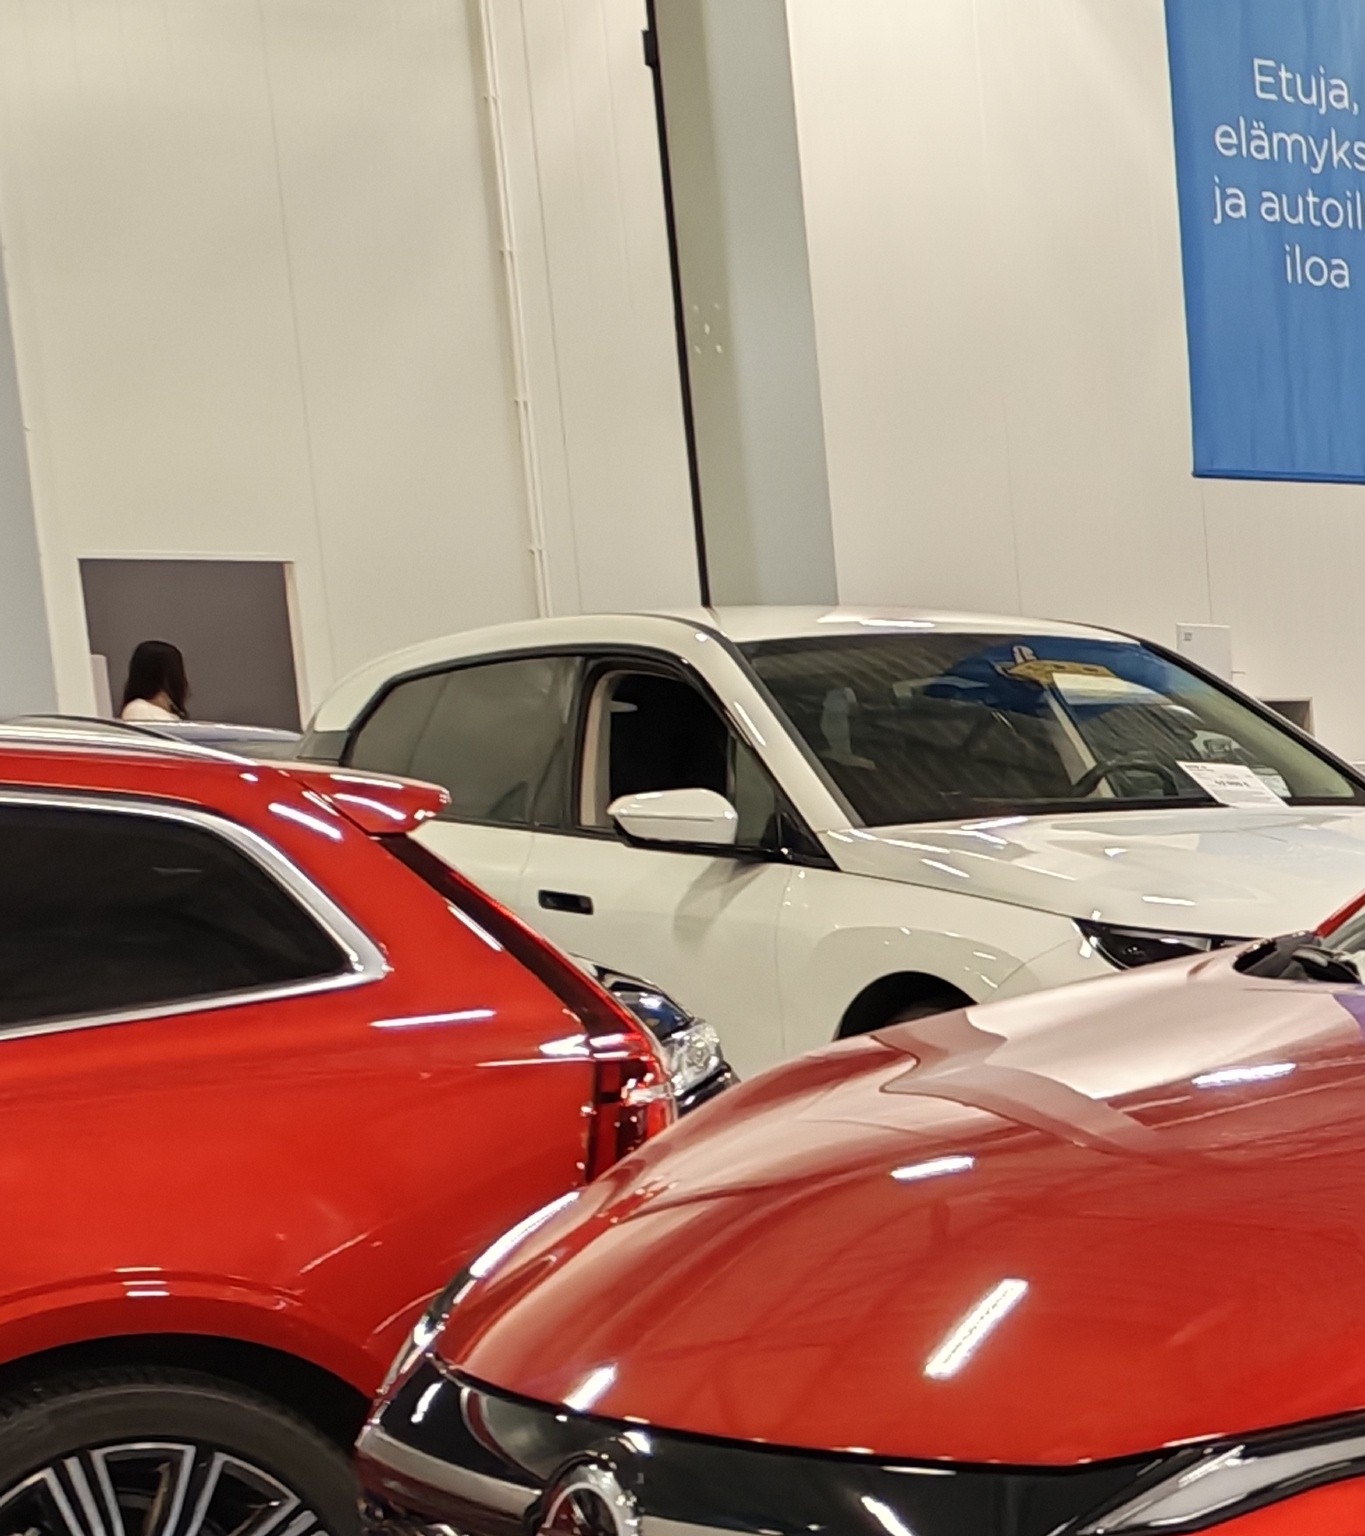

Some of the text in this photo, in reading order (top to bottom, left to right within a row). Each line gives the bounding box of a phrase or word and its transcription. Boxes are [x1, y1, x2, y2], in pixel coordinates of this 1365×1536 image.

[1253, 57, 1360, 115] Etuja,
[1213, 174, 1247, 225] ja
[1284, 243, 1350, 289] iloa
